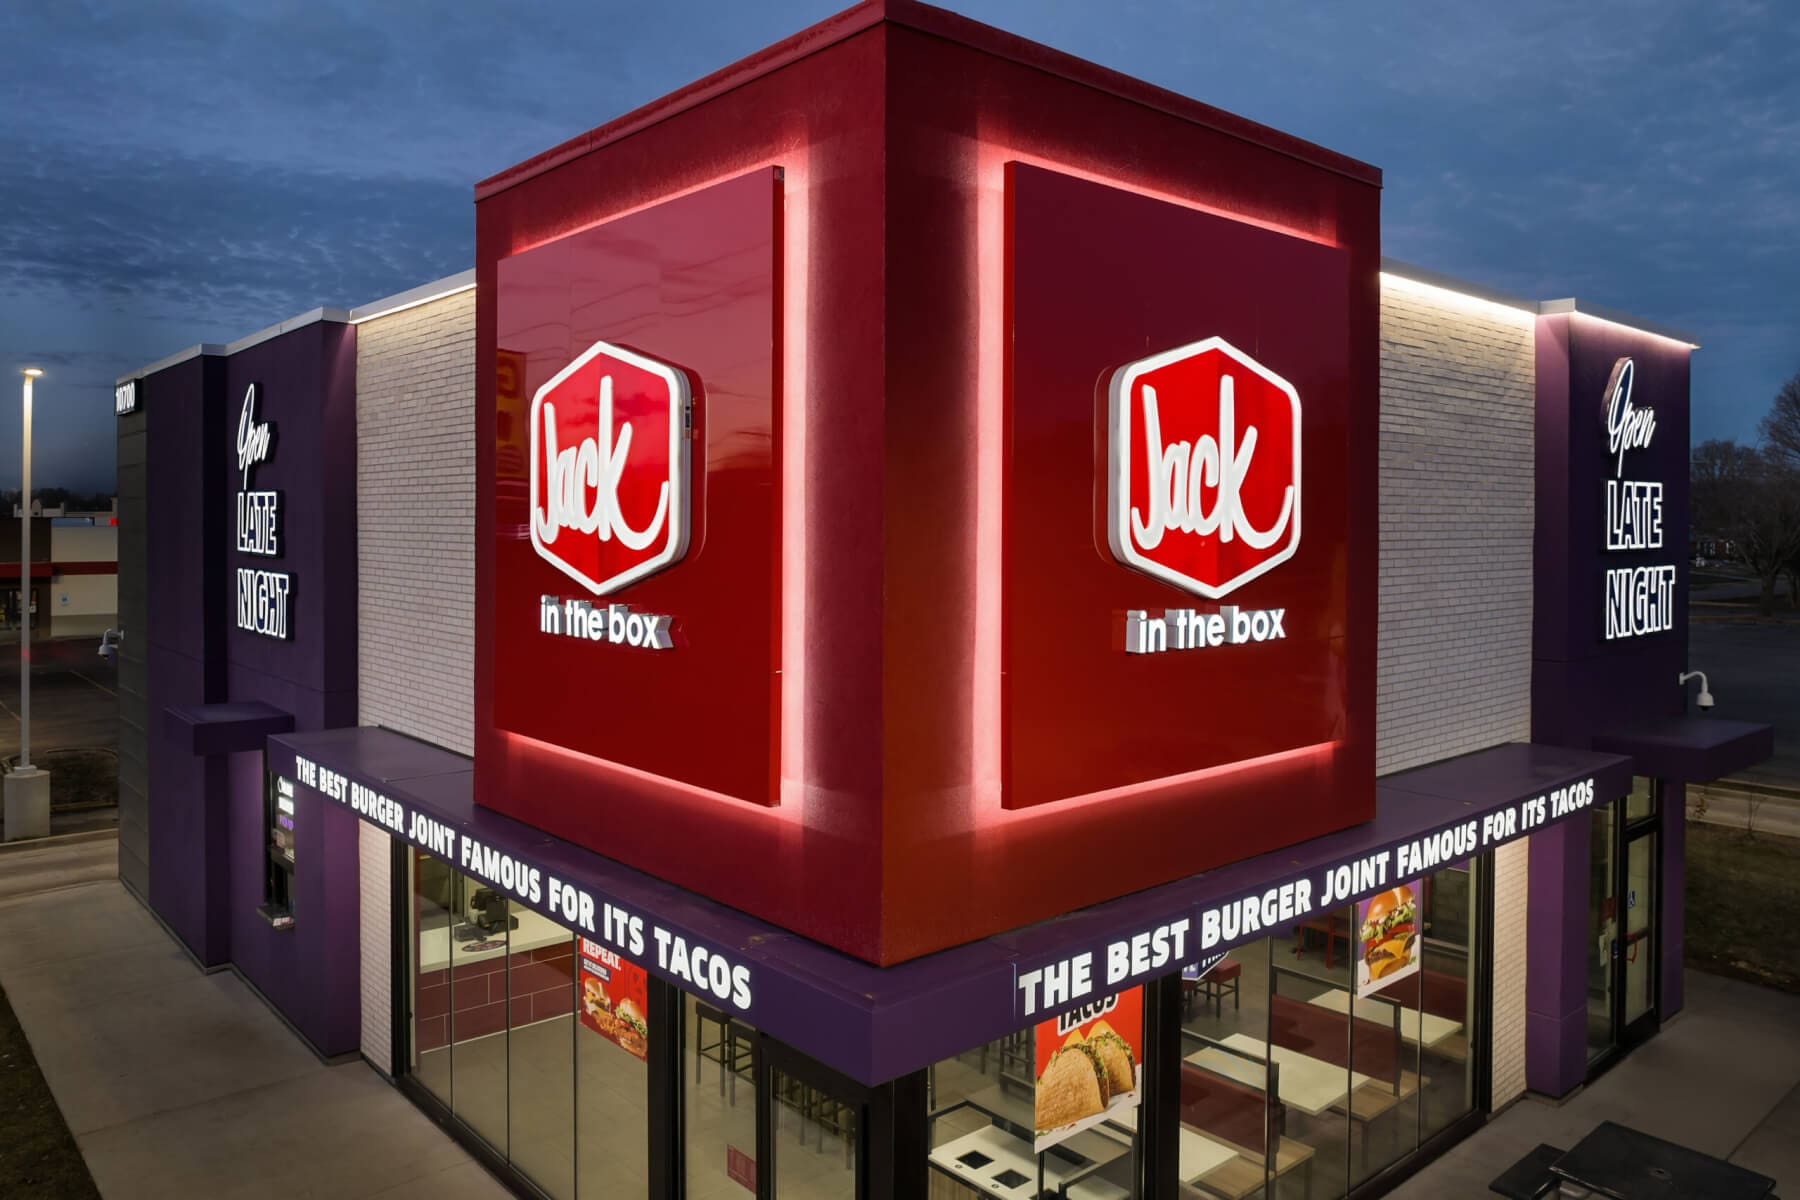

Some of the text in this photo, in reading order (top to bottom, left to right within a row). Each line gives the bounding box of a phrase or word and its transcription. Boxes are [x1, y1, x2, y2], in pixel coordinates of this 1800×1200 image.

[115, 380, 136, 413] 10700
[1607, 357, 1656, 478] Open
[237, 382, 271, 490] Open
[536, 375, 670, 551] Jack
[1130, 374, 1294, 551] Jack
[237, 491, 277, 555] LATE
[1606, 479, 1663, 550] LATE
[237, 567, 289, 639] NIGHT
[541, 595, 660, 649] in the box
[1139, 605, 1286, 654] in the box
[1605, 564, 1676, 640] NIGHT
[295, 755, 317, 788] THE
[320, 766, 348, 803] BEST
[352, 782, 405, 834] BURGER
[409, 810, 456, 859] JOINT
[461, 835, 542, 904] FAMOUS
[548, 876, 596, 933] FOR
[603, 903, 645, 956] ITS
[653, 926, 752, 1010] TACOS
[1018, 778, 1594, 1016] THE BEST BURGER JOINT FAMOUS FOR ITS TACOS
